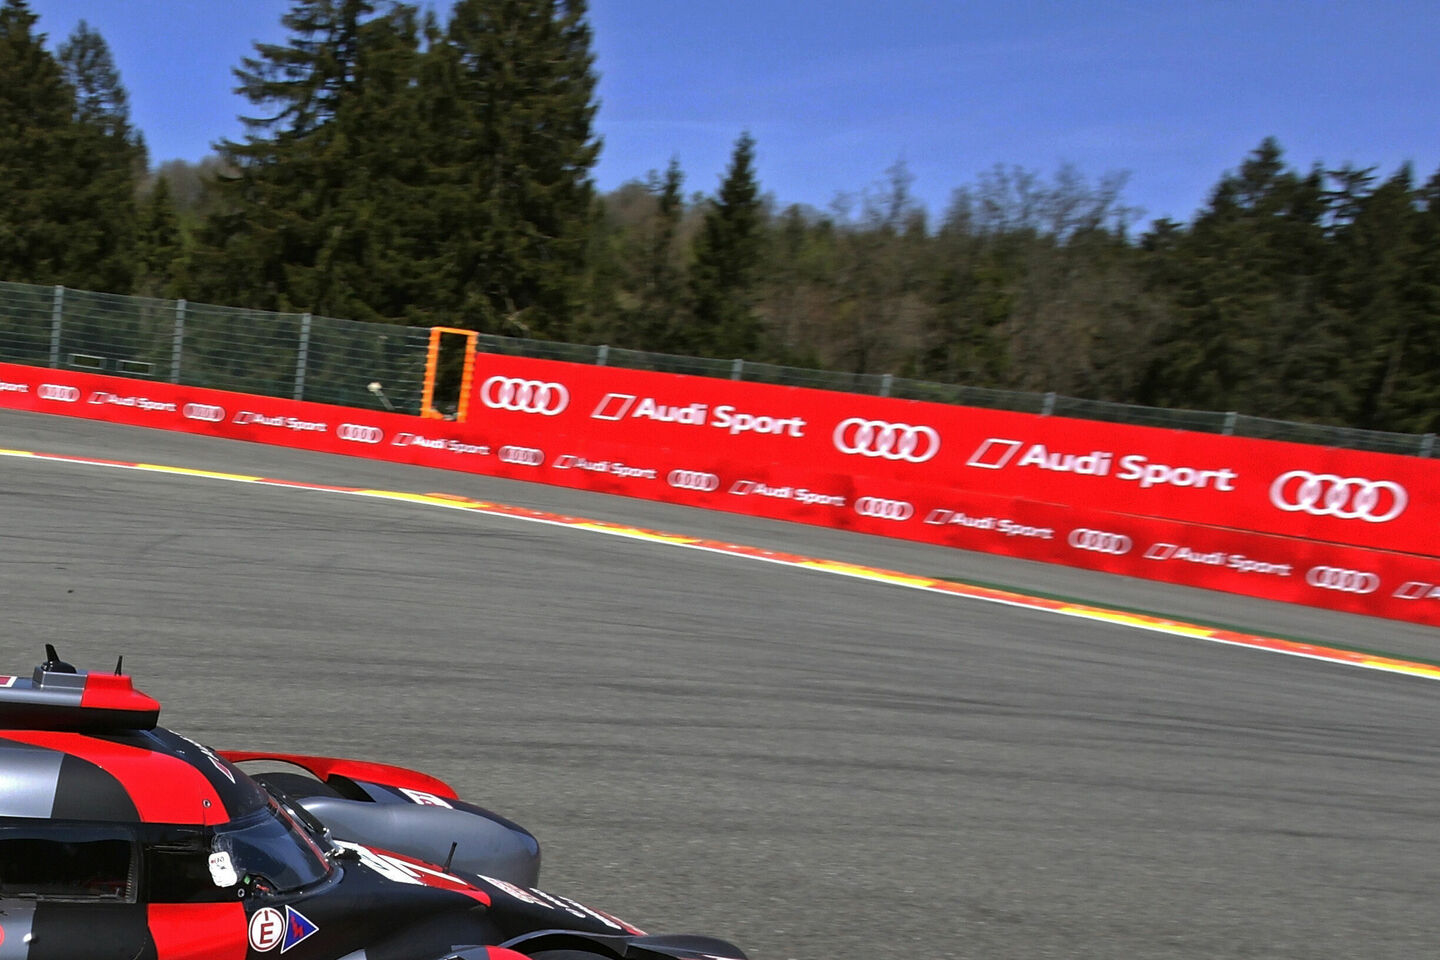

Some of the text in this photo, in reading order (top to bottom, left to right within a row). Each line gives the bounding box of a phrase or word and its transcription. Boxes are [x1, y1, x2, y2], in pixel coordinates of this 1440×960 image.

[632, 397, 807, 438] Audi Sport
[1017, 444, 1238, 492] Audi Sport
[753, 482, 846, 507] Audi Sport
[949, 512, 1055, 539] Audi Sport
[1172, 546, 1293, 577] Audi Sport
[260, 922, 274, 945] E
